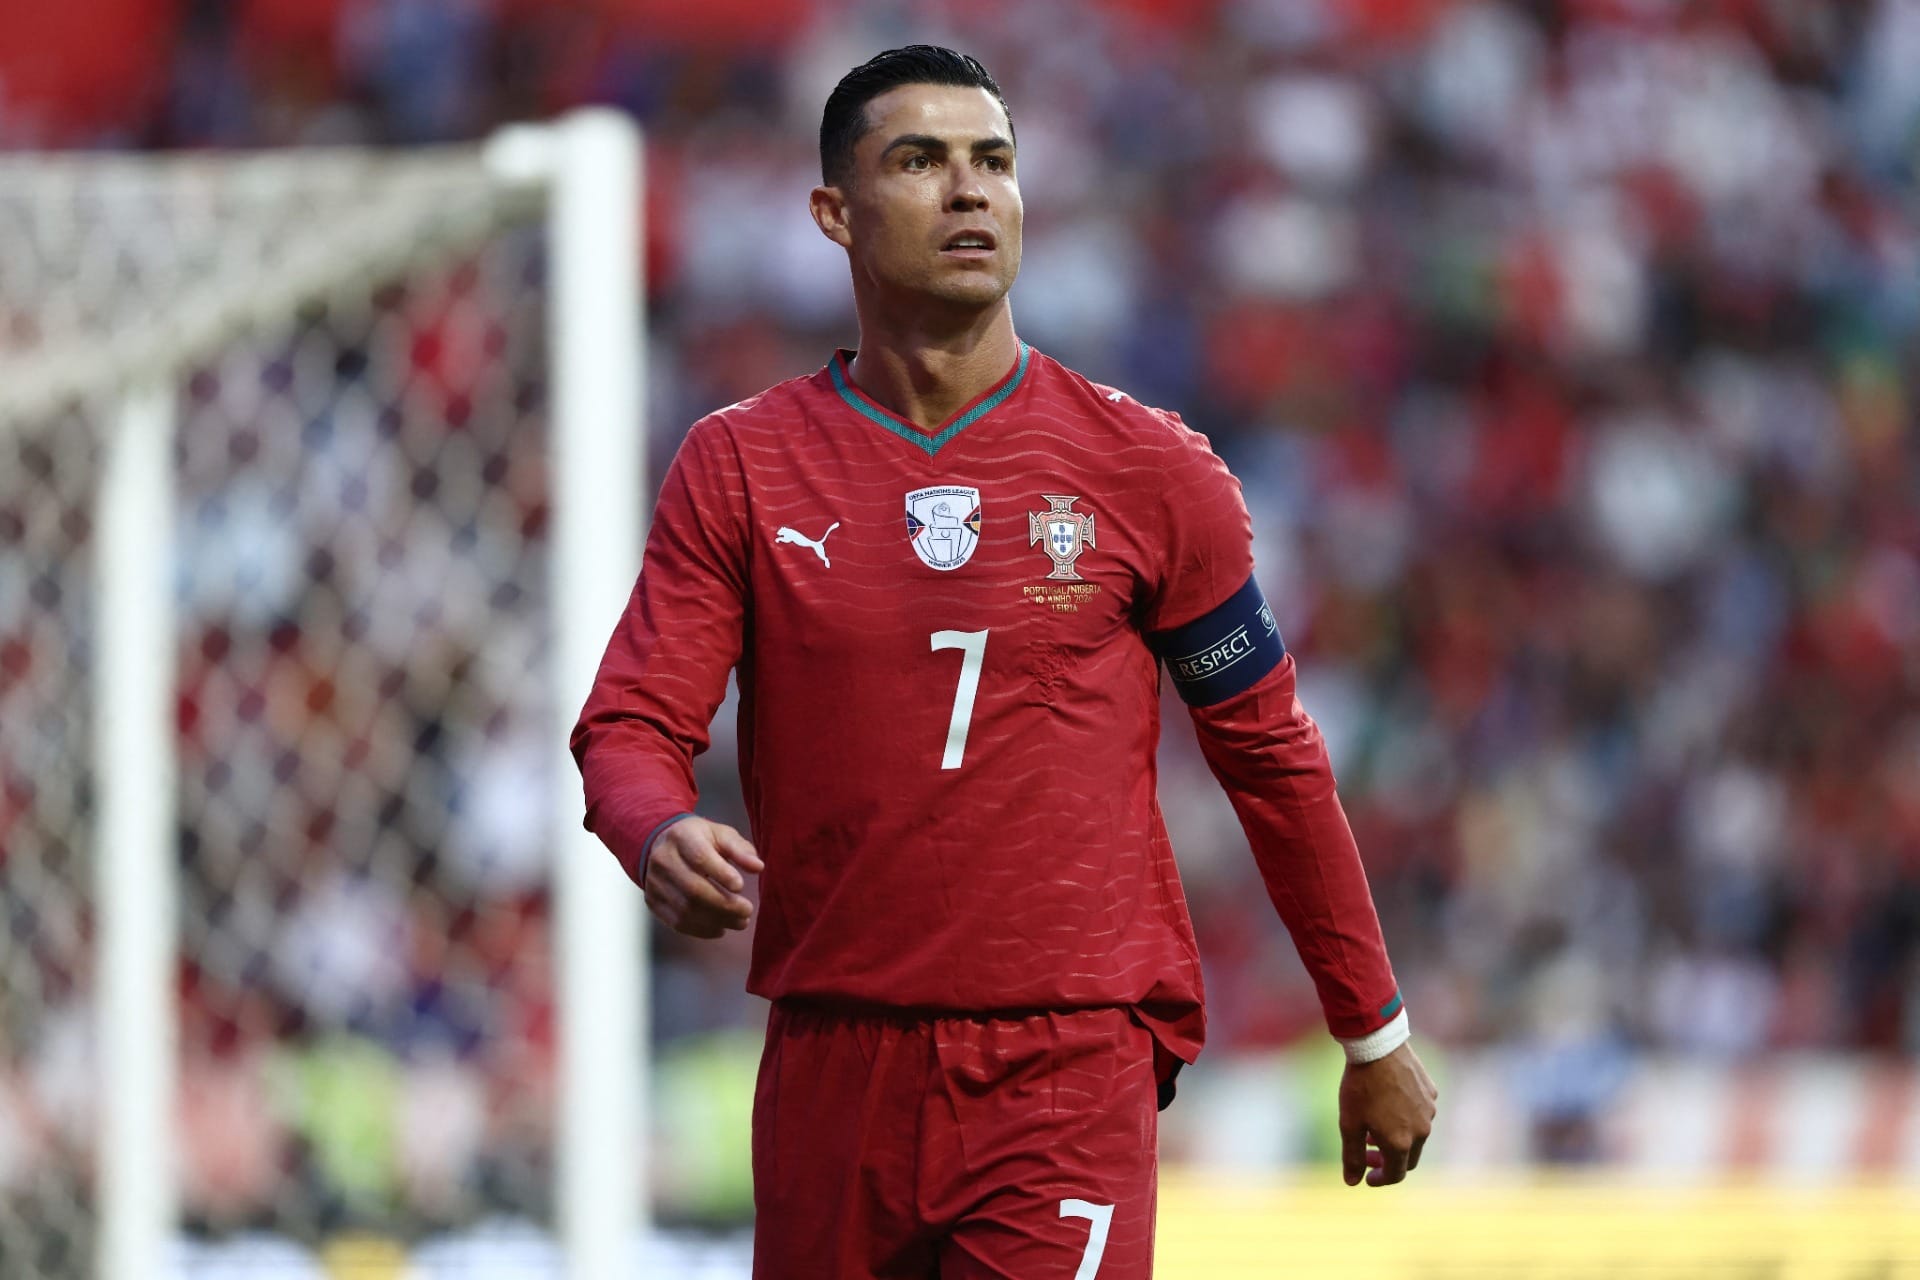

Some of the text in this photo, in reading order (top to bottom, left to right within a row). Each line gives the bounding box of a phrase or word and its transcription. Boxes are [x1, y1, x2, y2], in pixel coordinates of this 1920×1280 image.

[908, 488, 976, 501] UEFA NATIONS LEAGUE
[1035, 595, 1044, 604] 10
[1052, 603, 1078, 613] LEIRIA
[1179, 630, 1251, 676] RESPECT
[930, 628, 989, 770] 7
[1059, 1198, 1116, 1280] 7
